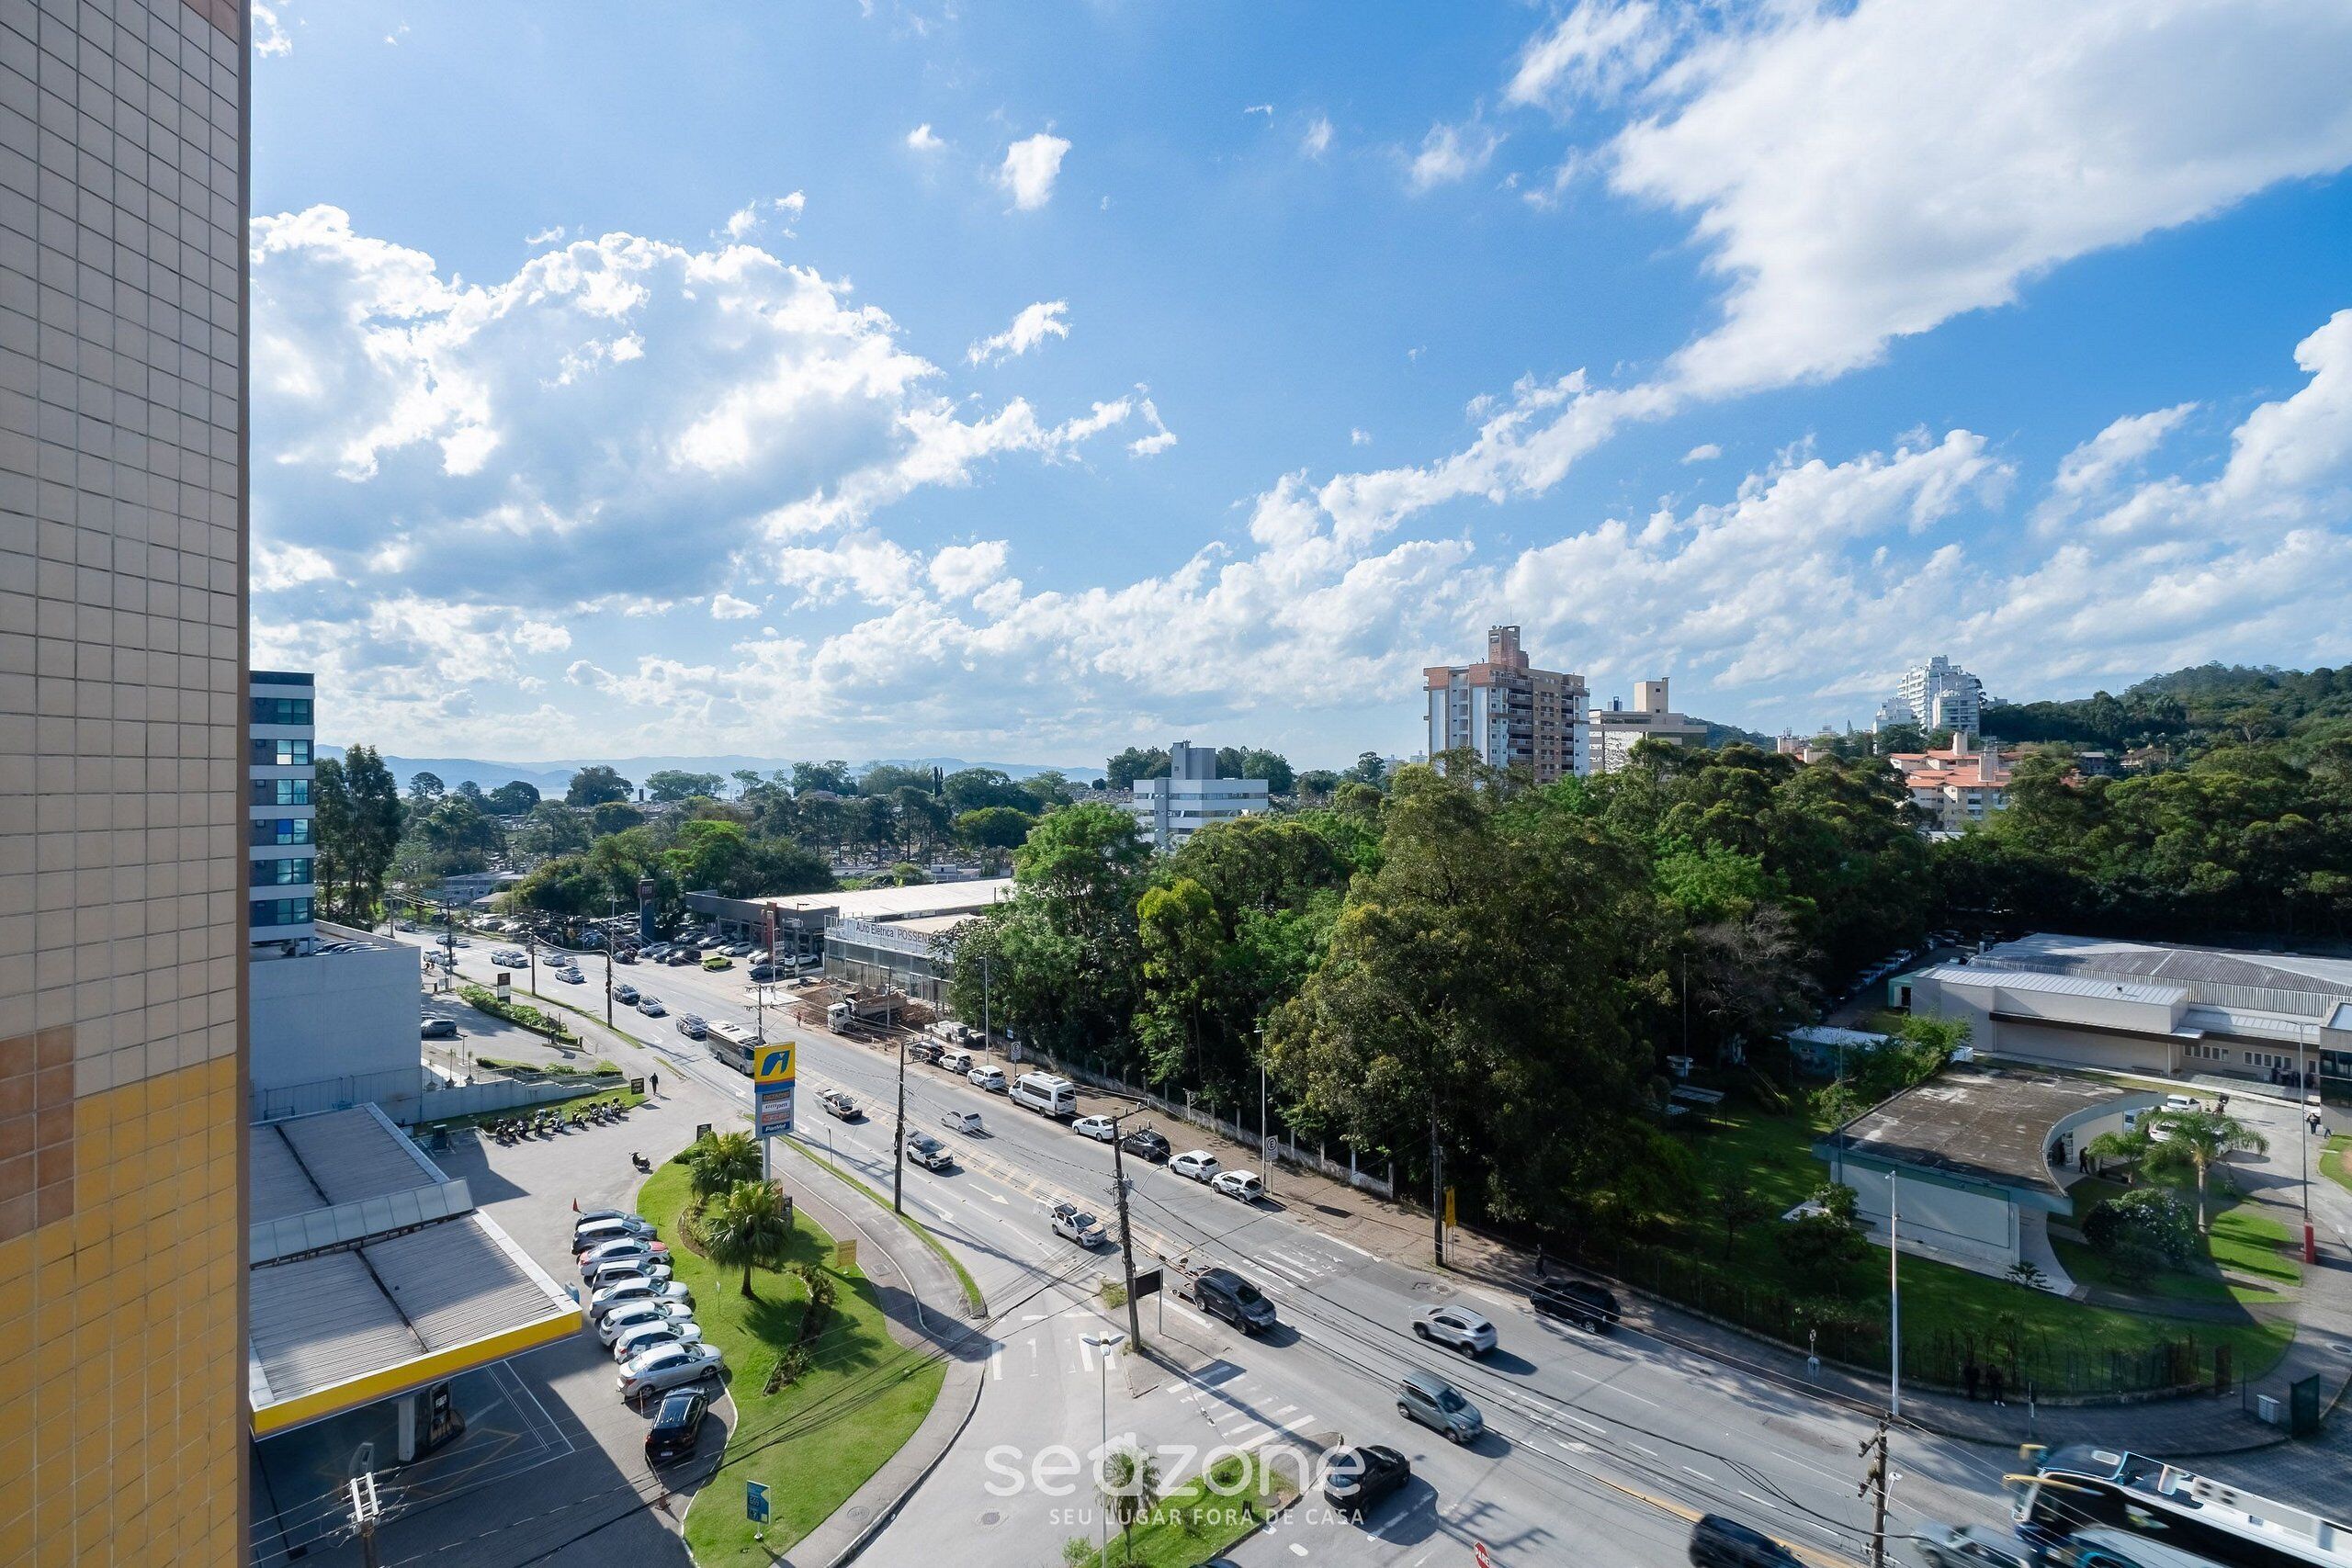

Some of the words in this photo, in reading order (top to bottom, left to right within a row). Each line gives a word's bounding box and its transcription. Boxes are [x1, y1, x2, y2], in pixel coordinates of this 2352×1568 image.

[641, 886, 652, 895] FIAT
[855, 921, 870, 933] Auto
[871, 923, 894, 938] Elétrica
[1475, 1546, 1489, 1566] PARE
